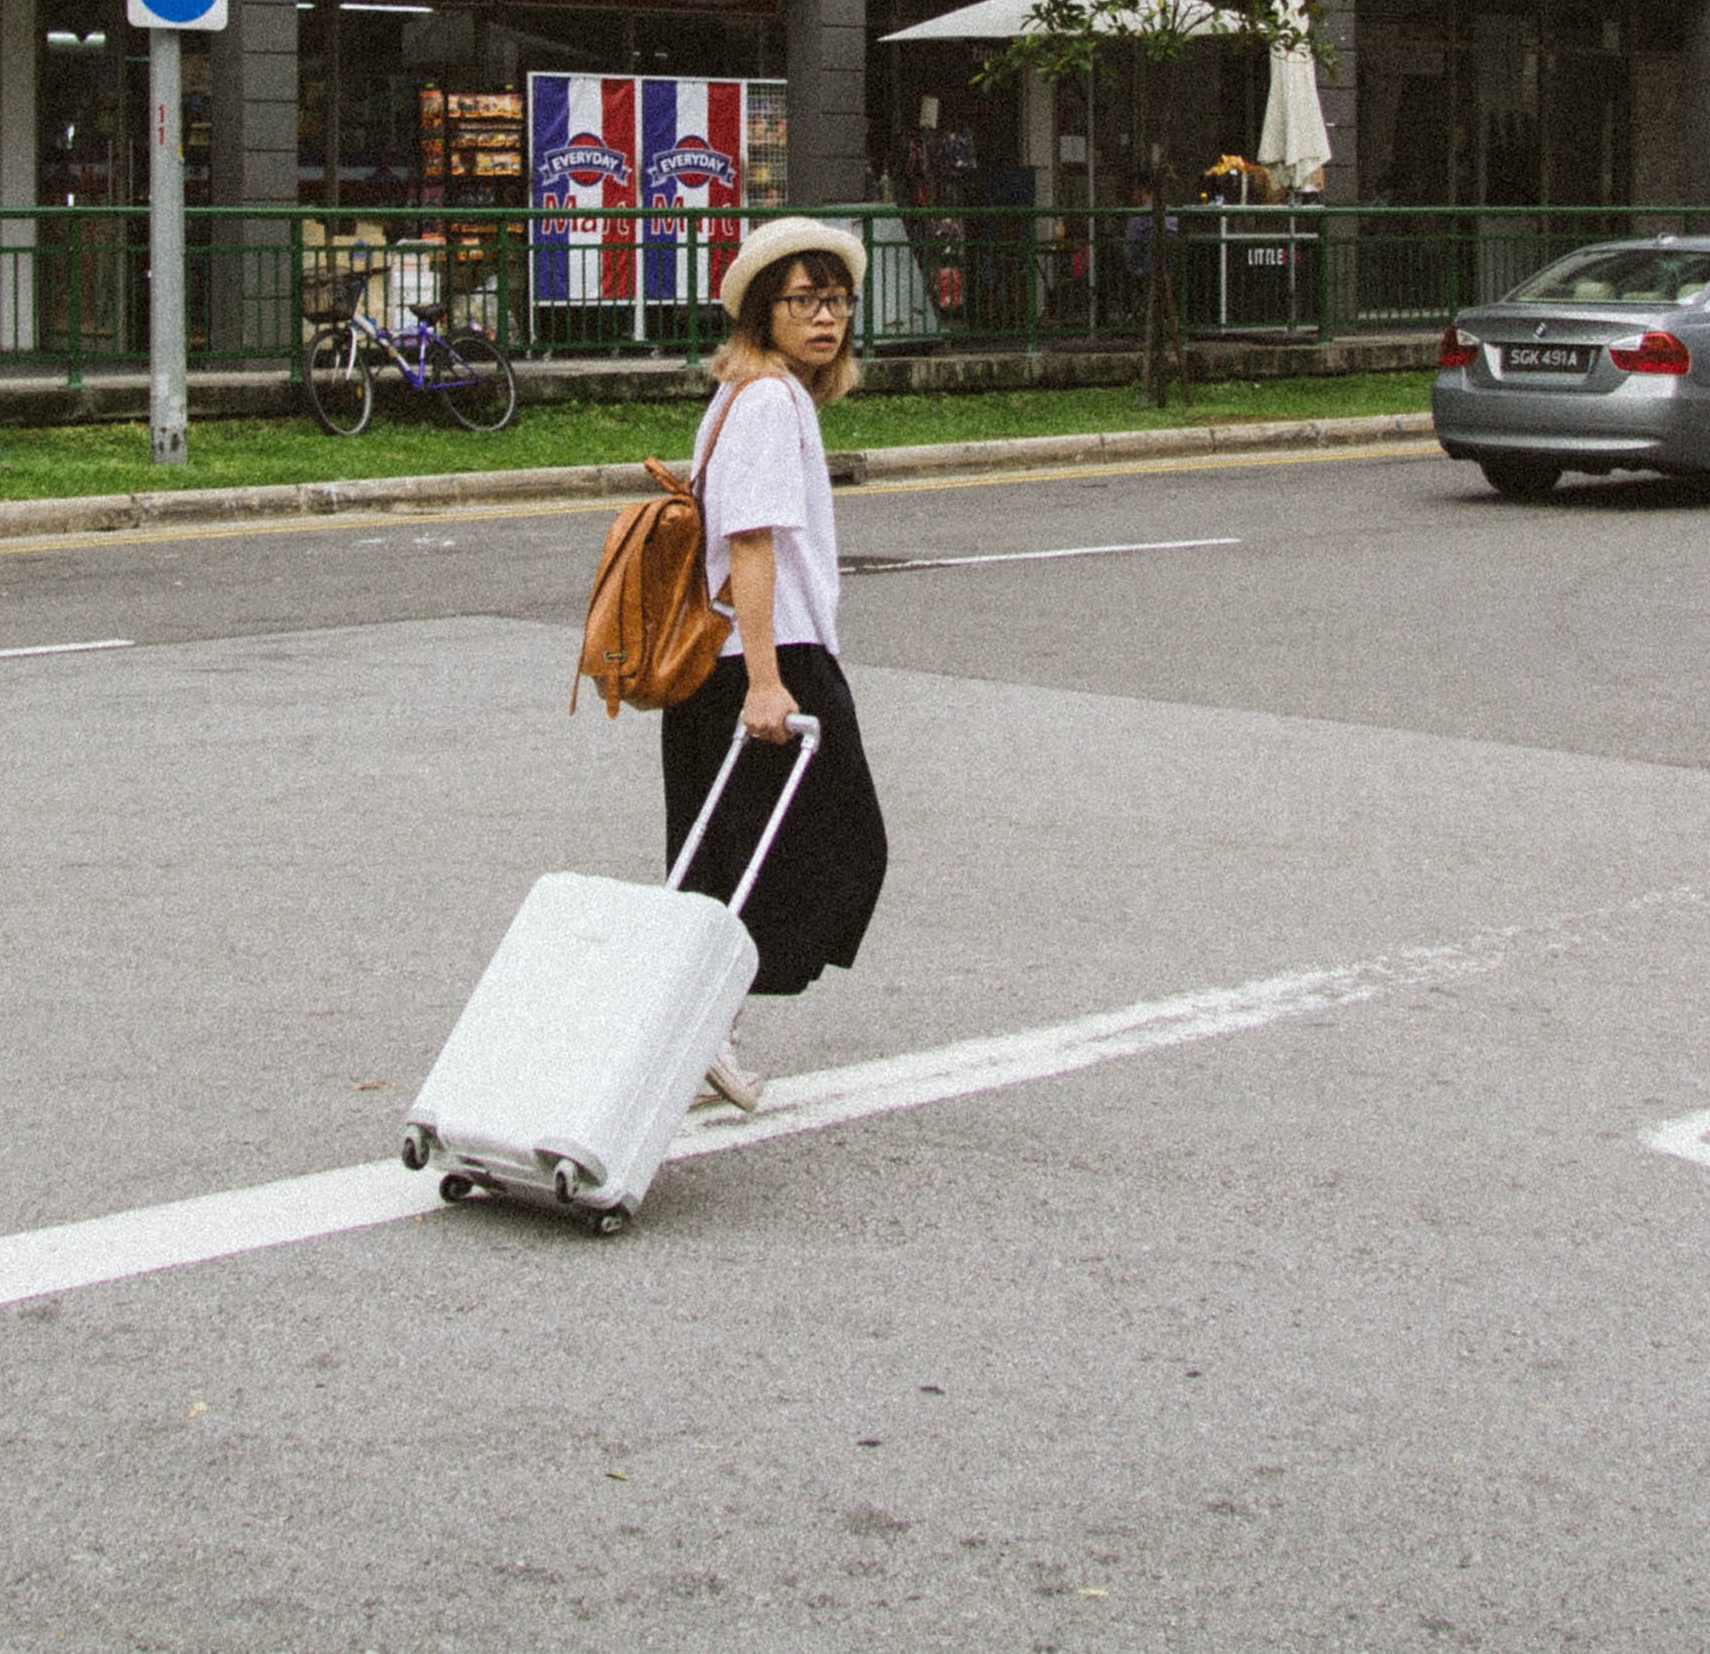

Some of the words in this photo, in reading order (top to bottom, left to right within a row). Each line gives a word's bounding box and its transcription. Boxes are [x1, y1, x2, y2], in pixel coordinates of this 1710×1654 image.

[551, 152, 620, 171] EVERYDAY
[659, 154, 726, 173] EVERYDAY
[650, 193, 735, 236] Mrt
[1510, 349, 1540, 365] SGK
